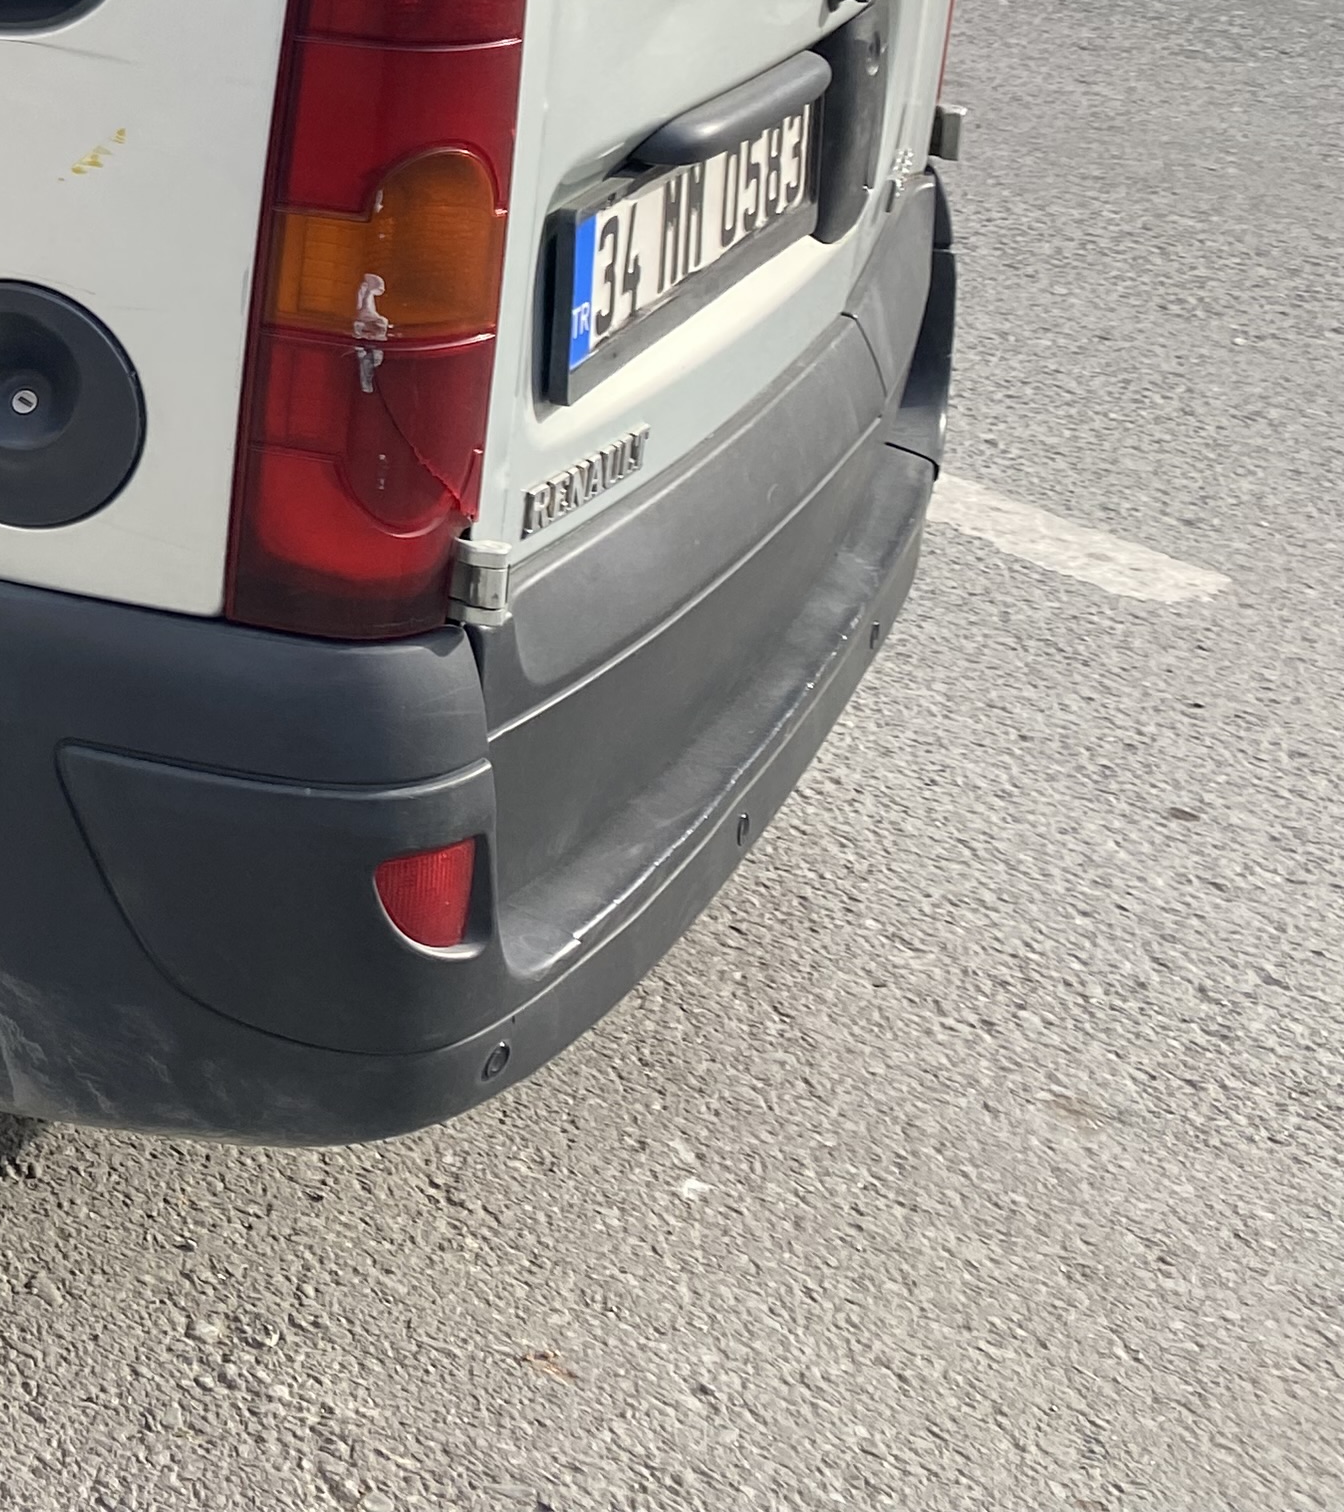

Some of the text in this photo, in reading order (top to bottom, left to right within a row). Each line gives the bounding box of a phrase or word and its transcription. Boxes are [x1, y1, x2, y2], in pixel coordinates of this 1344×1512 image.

[571, 301, 591, 339] TR
[595, 199, 642, 336] 34
[520, 422, 651, 541] RENAULT
